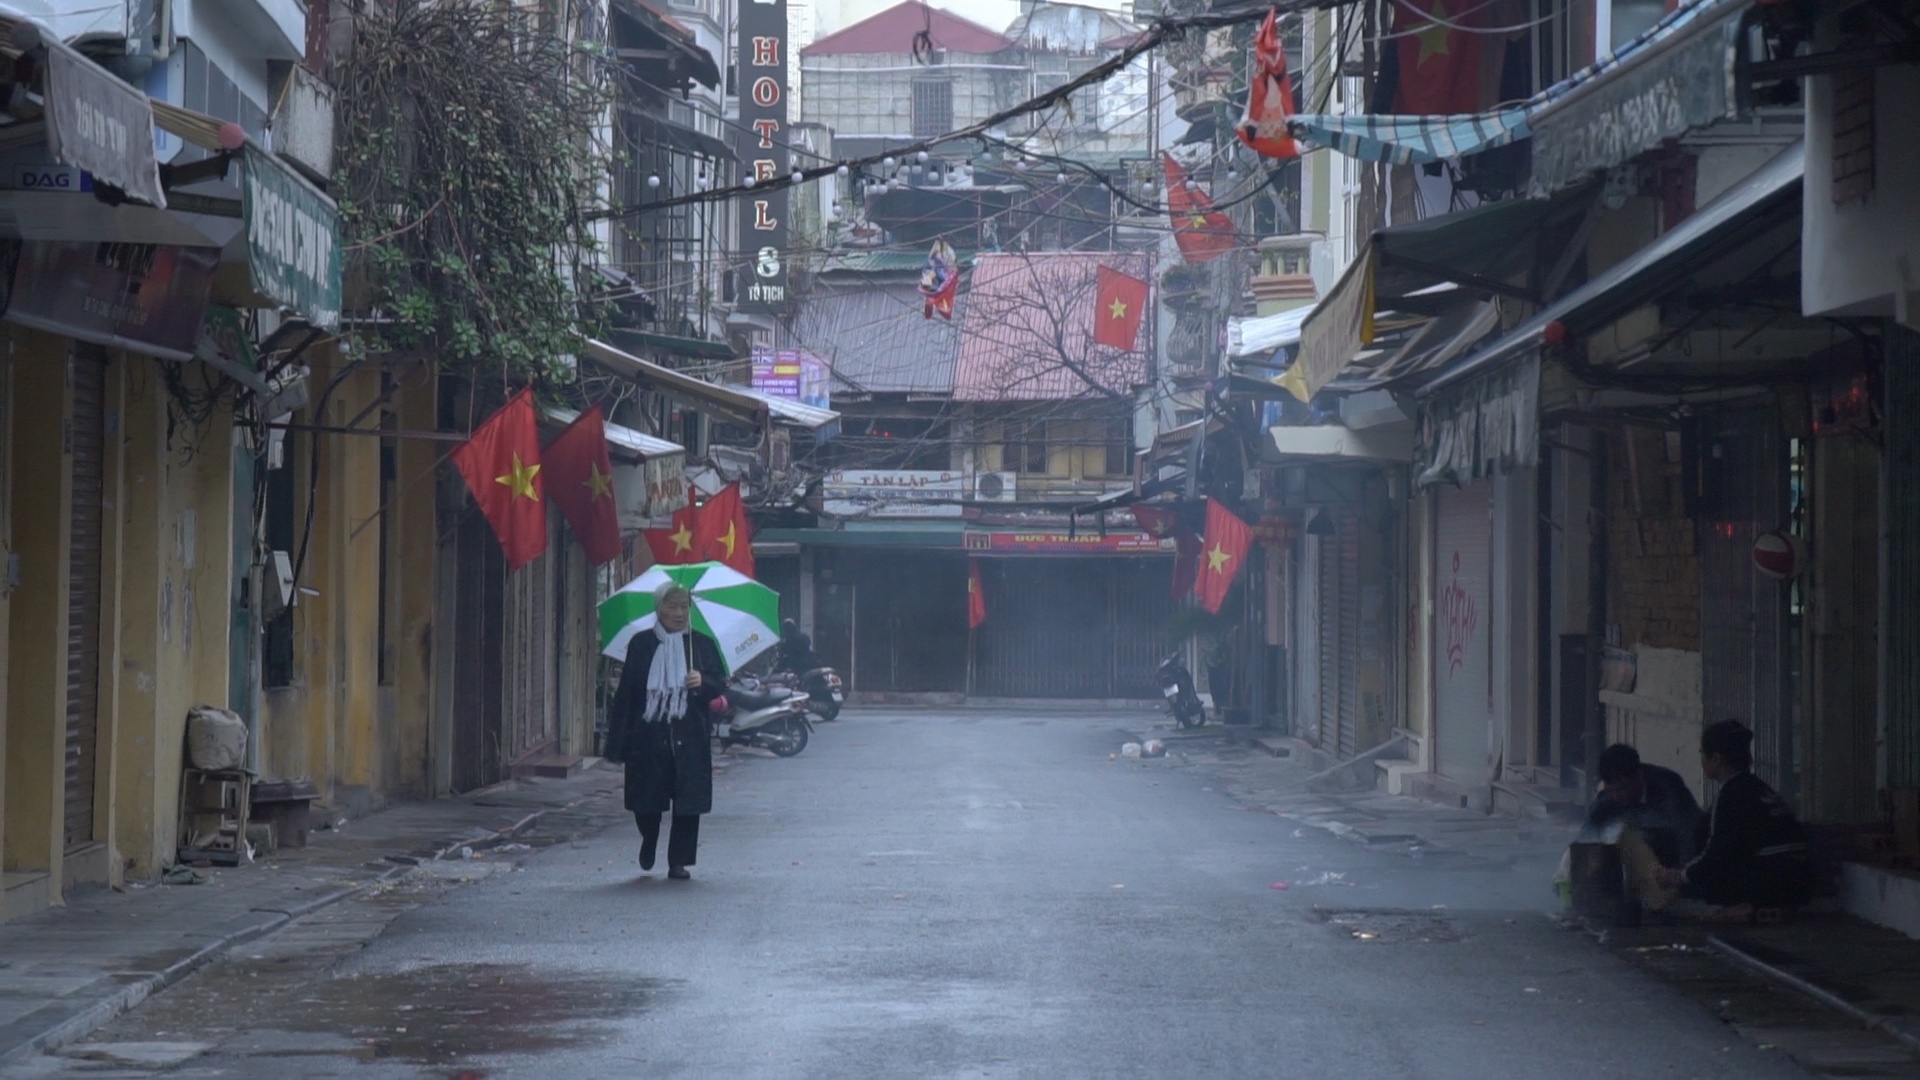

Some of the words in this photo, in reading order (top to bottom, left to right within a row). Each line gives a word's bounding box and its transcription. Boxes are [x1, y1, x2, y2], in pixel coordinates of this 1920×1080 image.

[752, 36, 781, 230] HOTEL
[22, 172, 69, 187] DAG
[756, 247, 781, 278] 8
[747, 282, 760, 301] TÔ
[762, 285, 784, 304] TỊCH
